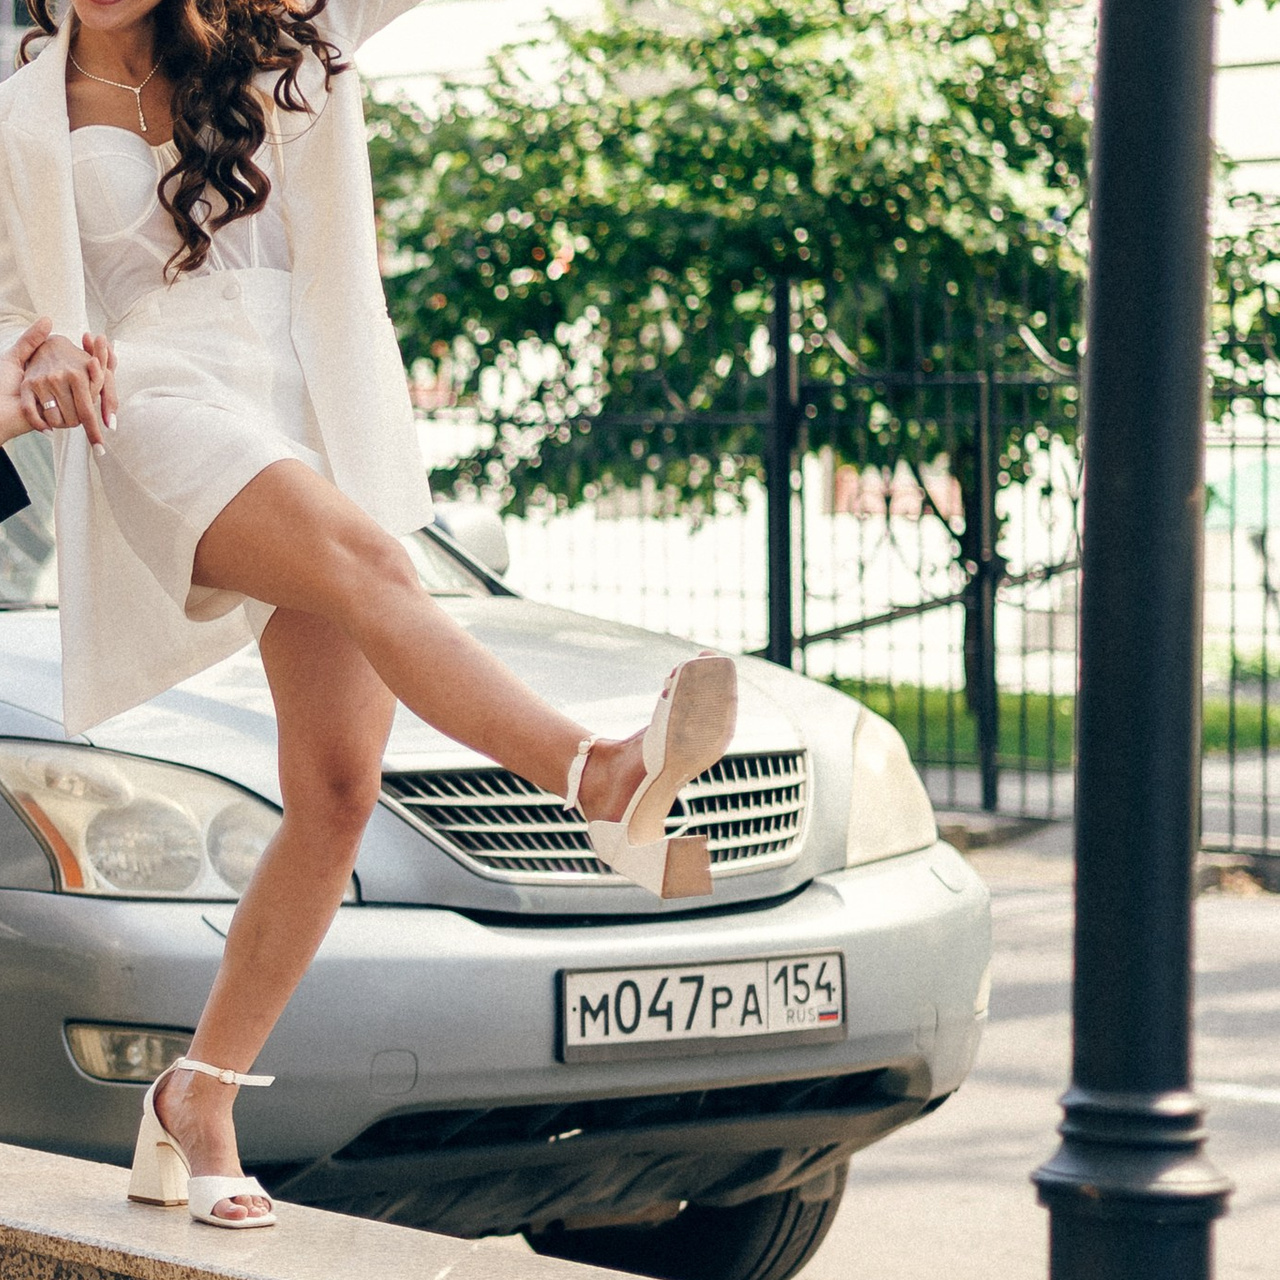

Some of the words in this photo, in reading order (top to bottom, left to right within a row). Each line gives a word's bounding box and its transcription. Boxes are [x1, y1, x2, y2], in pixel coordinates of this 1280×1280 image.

[579, 974, 763, 1038] М047РА
[773, 961, 833, 1007] 154
[785, 1006, 816, 1024] RUS
